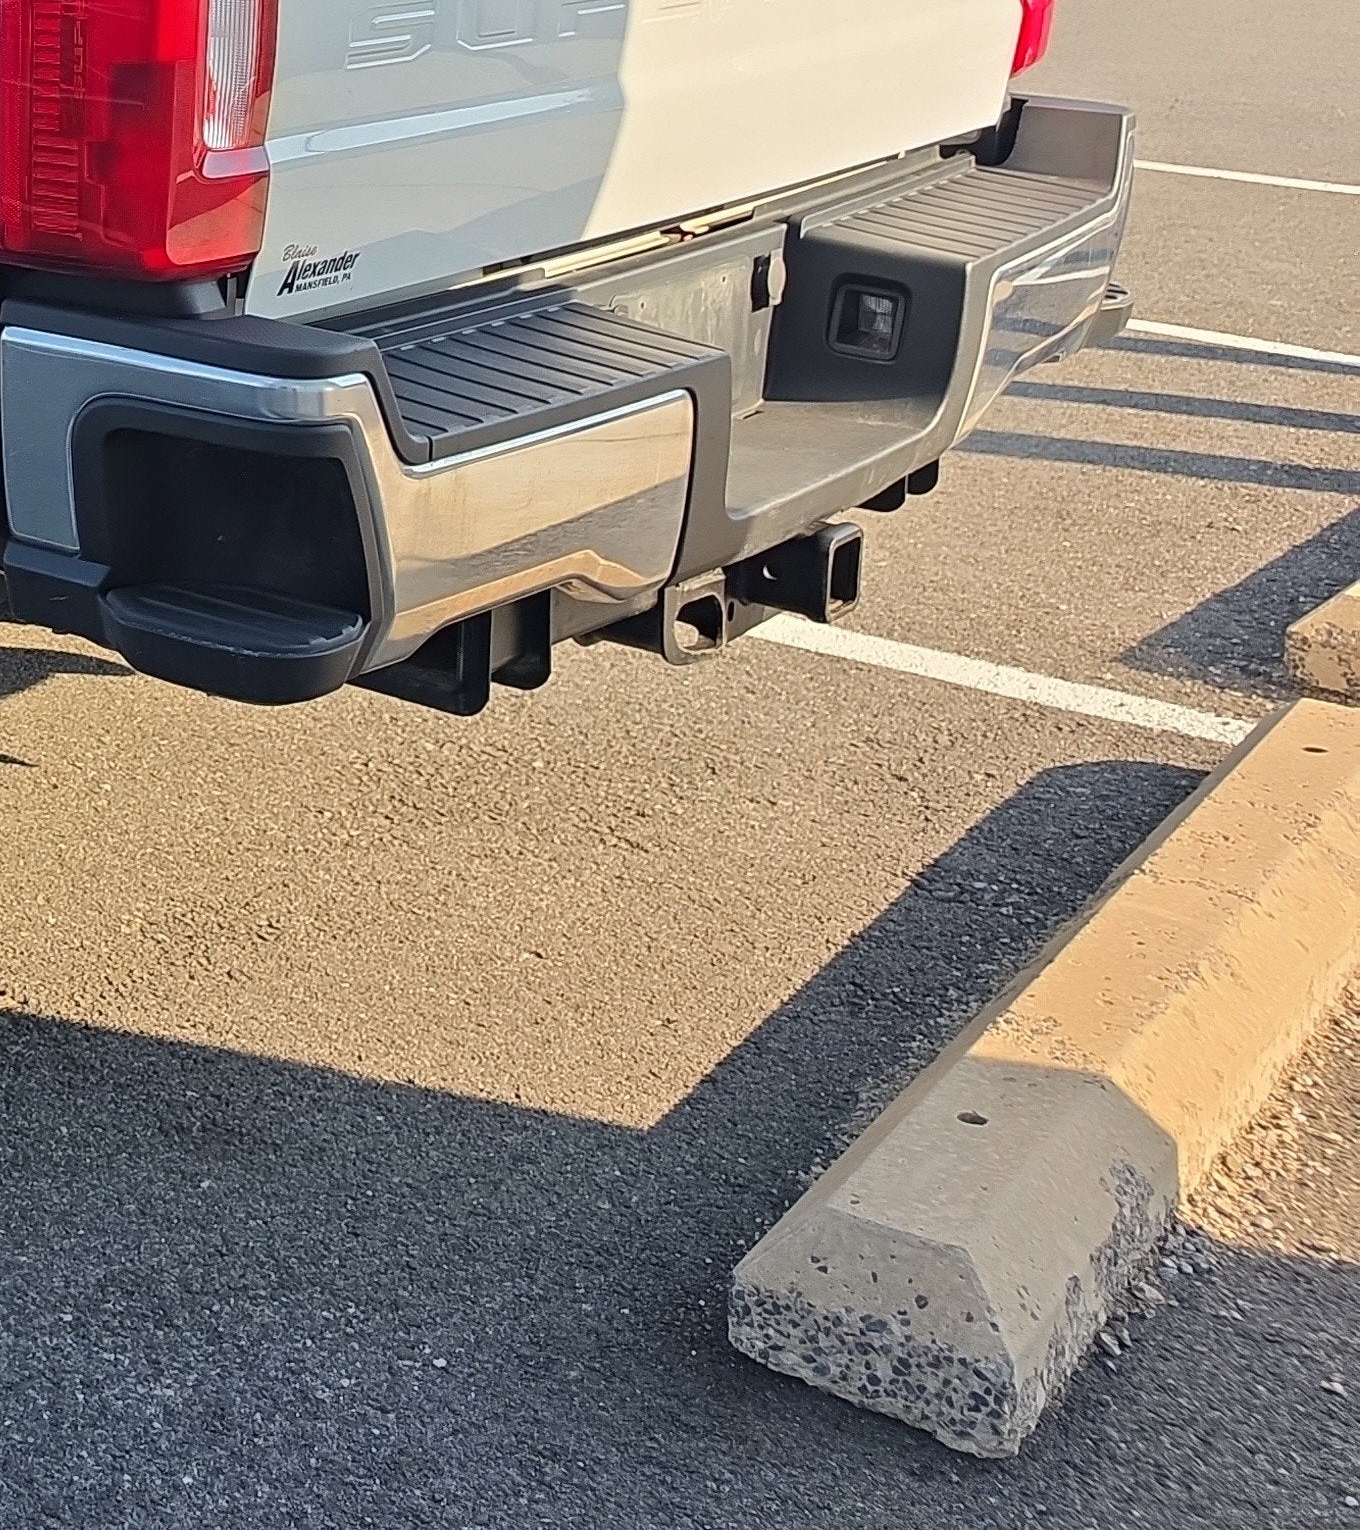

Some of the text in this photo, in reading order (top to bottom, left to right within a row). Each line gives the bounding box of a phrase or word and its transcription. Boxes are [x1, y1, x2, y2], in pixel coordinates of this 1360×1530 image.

[282, 243, 318, 262] Blaise
[276, 251, 361, 296] Alexander
[294, 272, 352, 293] MANSFIELD, PA
